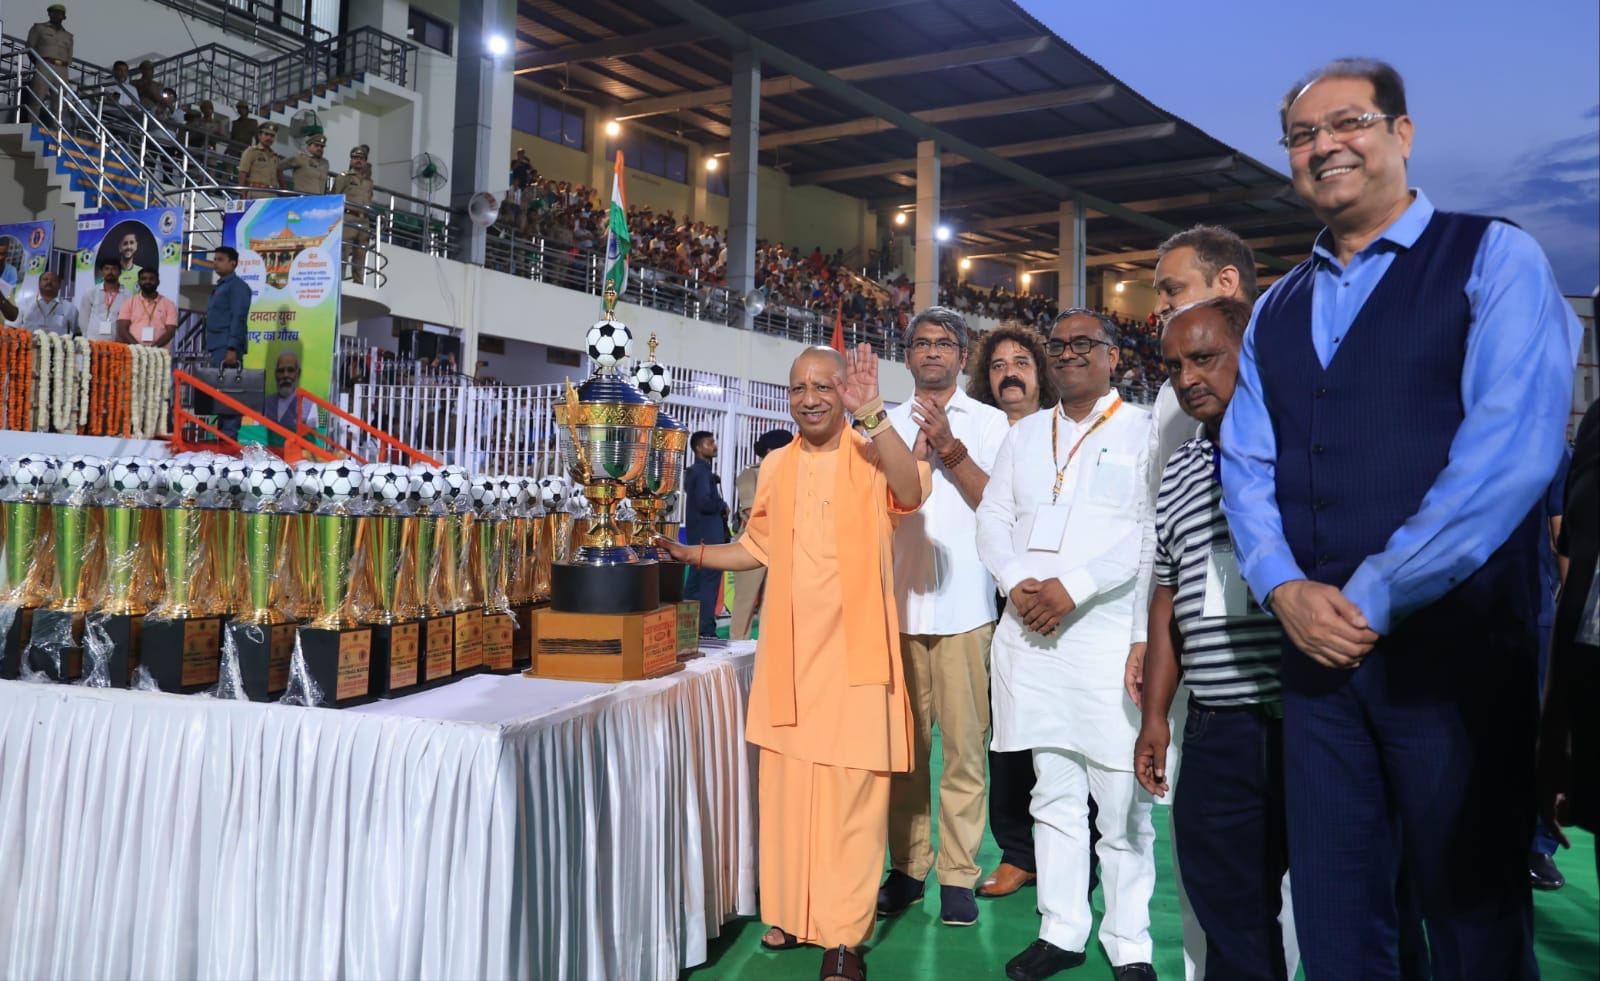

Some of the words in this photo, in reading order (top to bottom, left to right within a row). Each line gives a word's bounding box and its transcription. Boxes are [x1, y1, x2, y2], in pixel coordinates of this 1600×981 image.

[250, 311, 277, 322] दमदार
[278, 311, 296, 326] युवा
[248, 331, 261, 344] ाष्ट्र
[263, 331, 276, 341] का
[277, 326, 299, 341] गौरव
